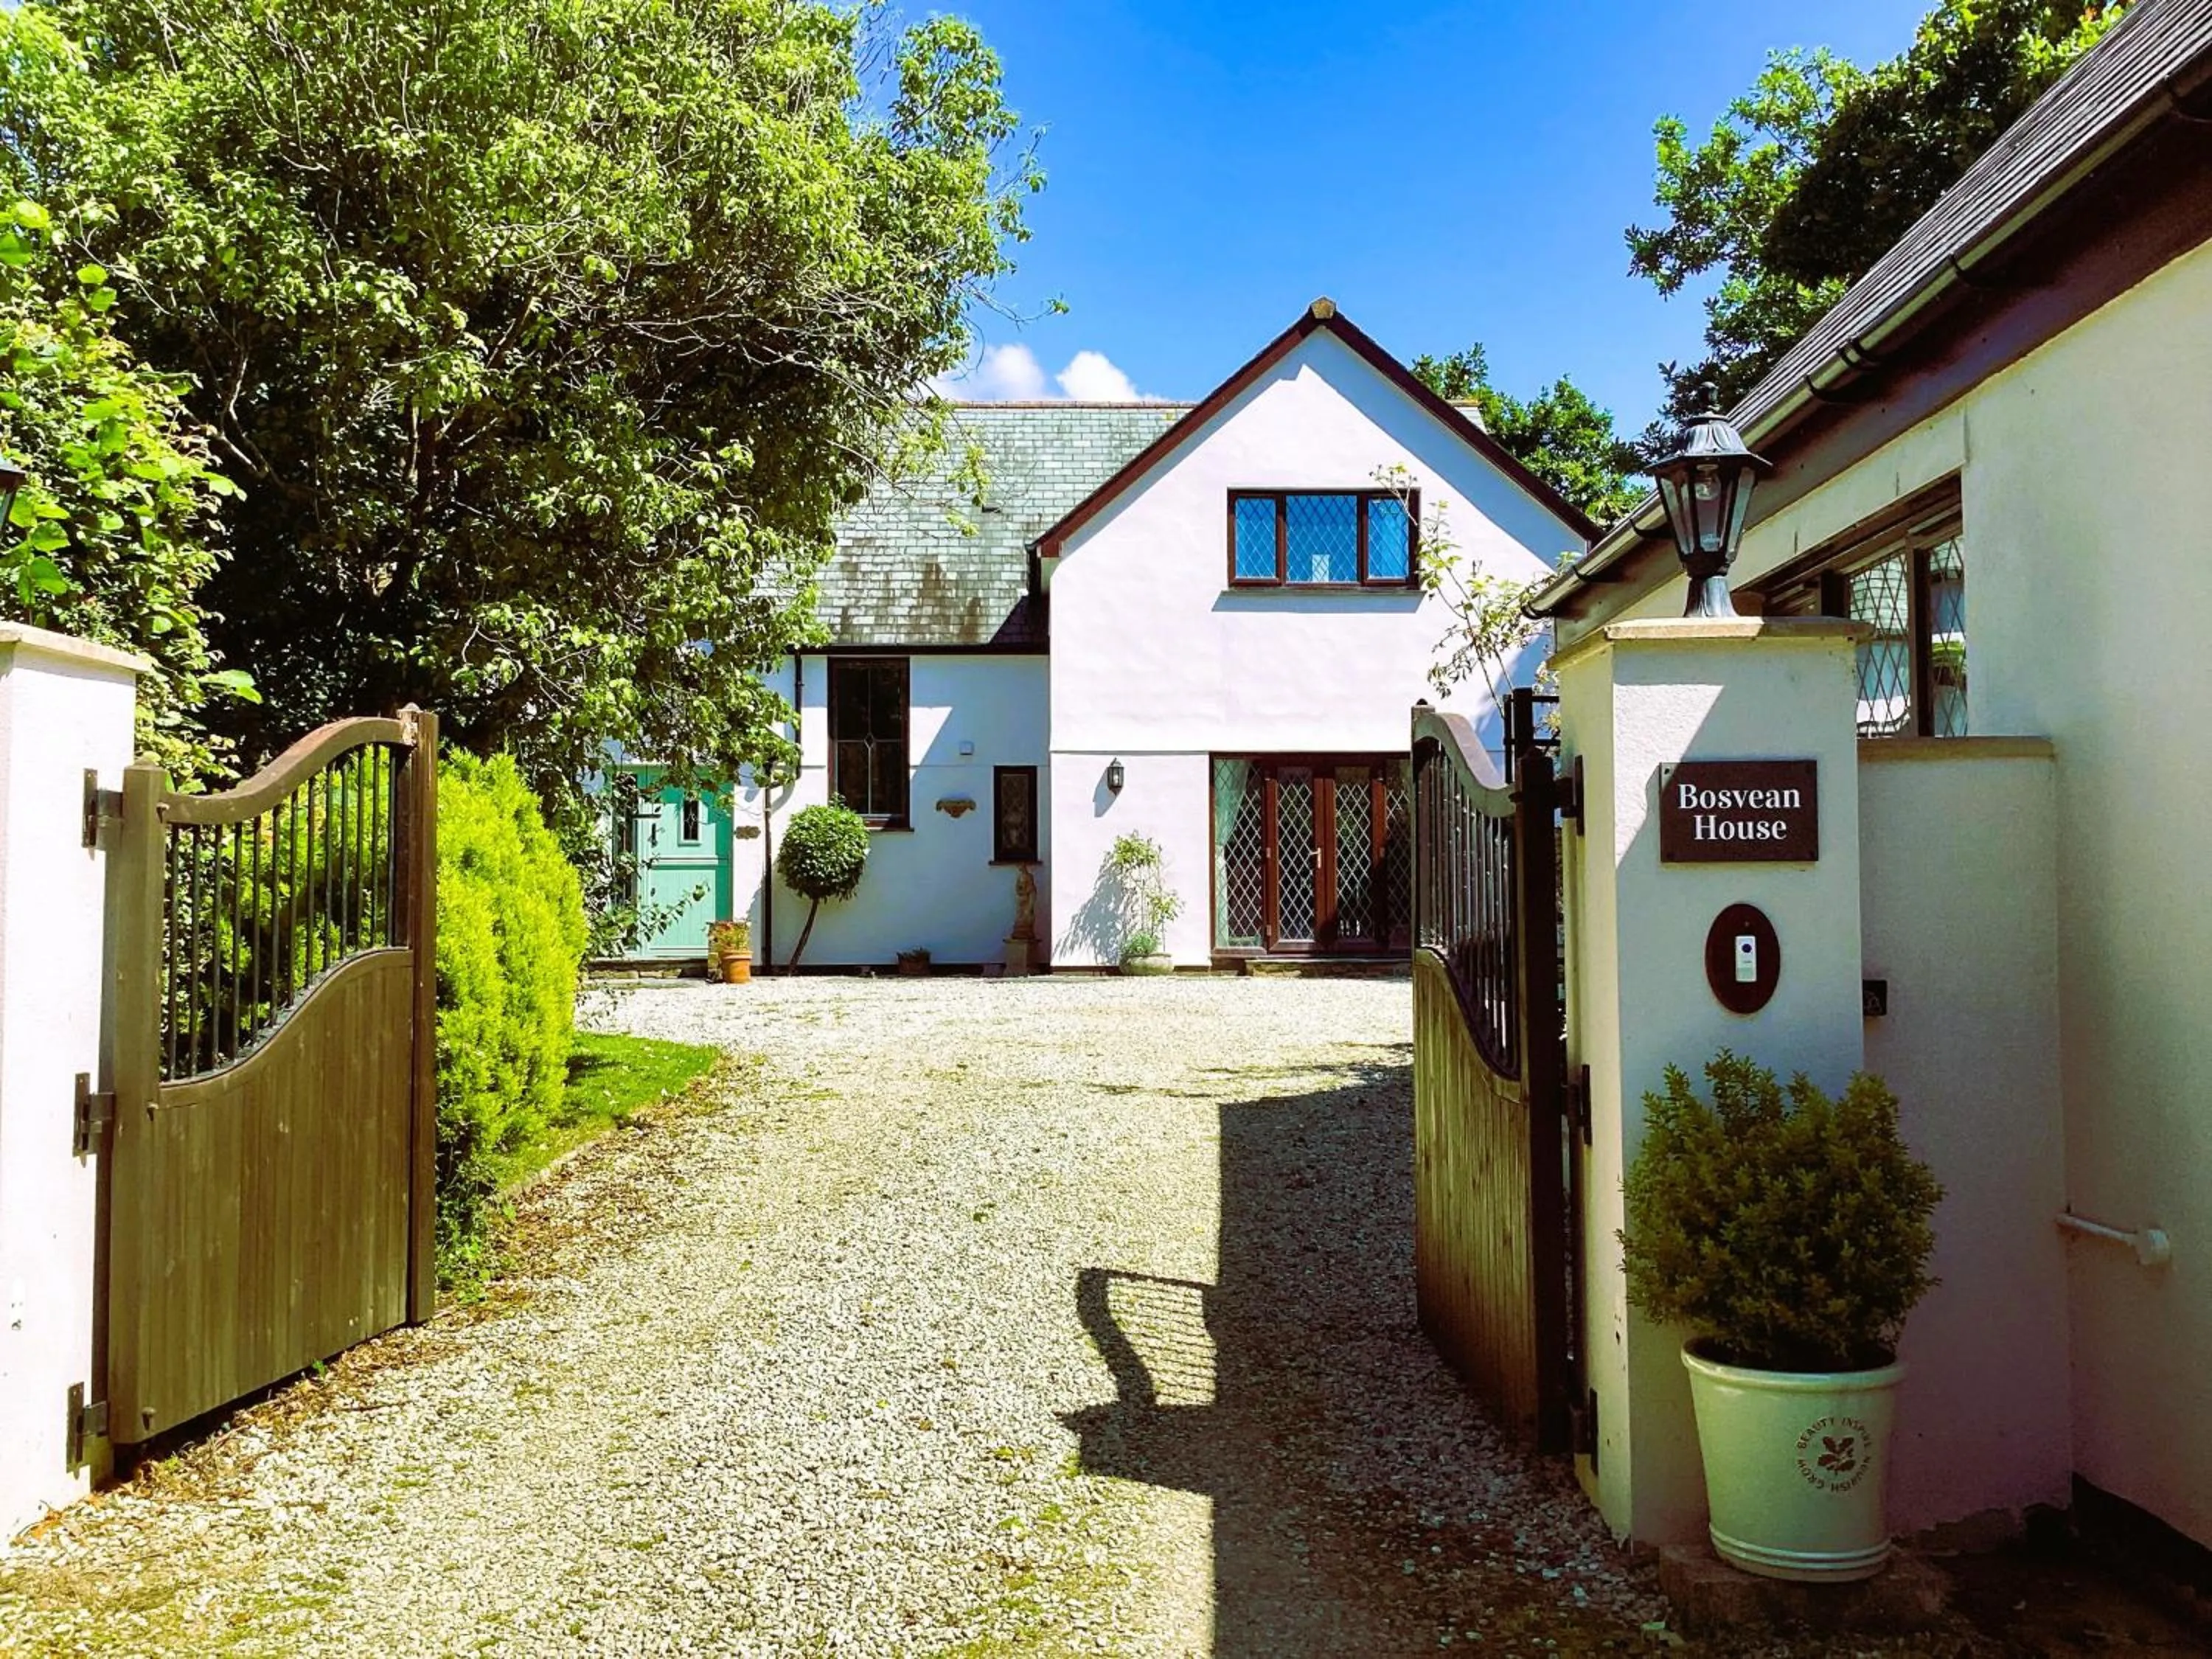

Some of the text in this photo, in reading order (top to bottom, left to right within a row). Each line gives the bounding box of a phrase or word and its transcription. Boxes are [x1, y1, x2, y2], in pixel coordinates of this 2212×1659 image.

[1678, 784, 1801, 809] Bosvean
[1694, 815, 1787, 841] House
[1797, 1416, 1834, 1449] BEAUTY
[1797, 1459, 1825, 1489] GROW
